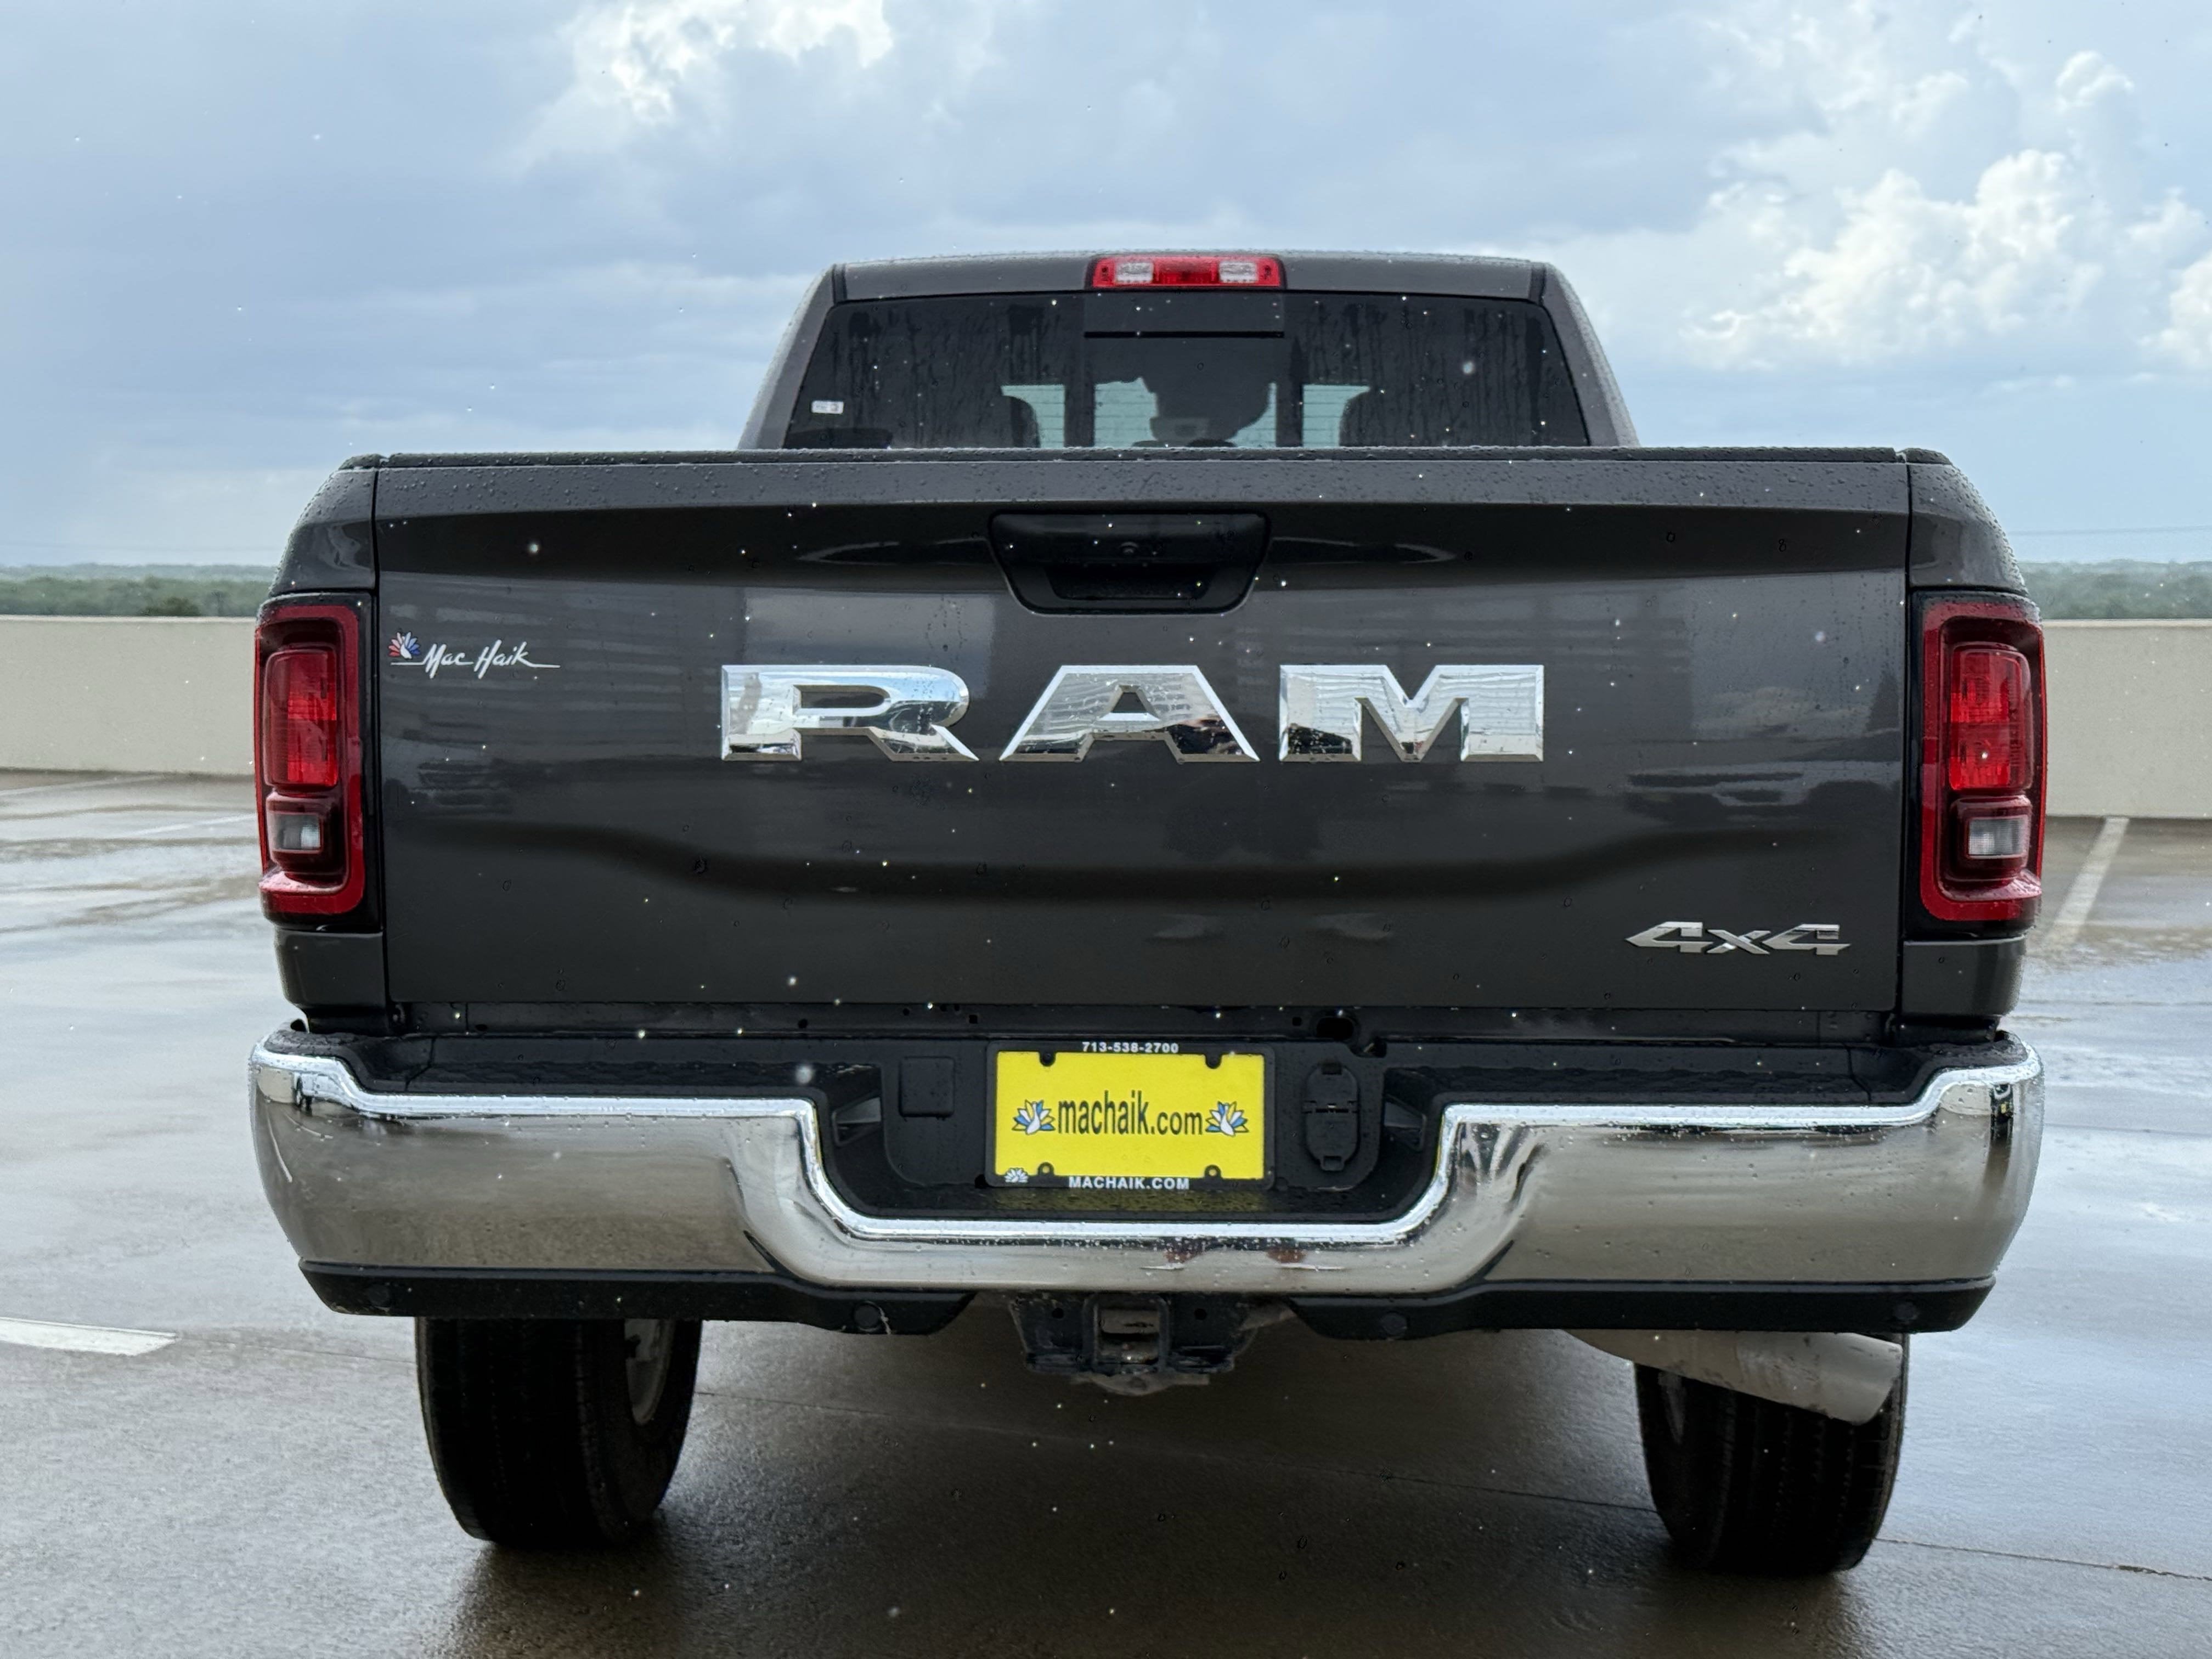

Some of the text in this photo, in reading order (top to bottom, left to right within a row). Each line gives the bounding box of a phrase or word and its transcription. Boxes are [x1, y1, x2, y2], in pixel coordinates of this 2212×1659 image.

[405, 639, 560, 680] Mac Haik
[721, 663, 1545, 762] RAM
[1081, 1041, 1180, 1054] 713-538-2700
[1057, 1090, 1204, 1136] machaik.com
[1068, 1176, 1190, 1190] MACHAIK.COM
